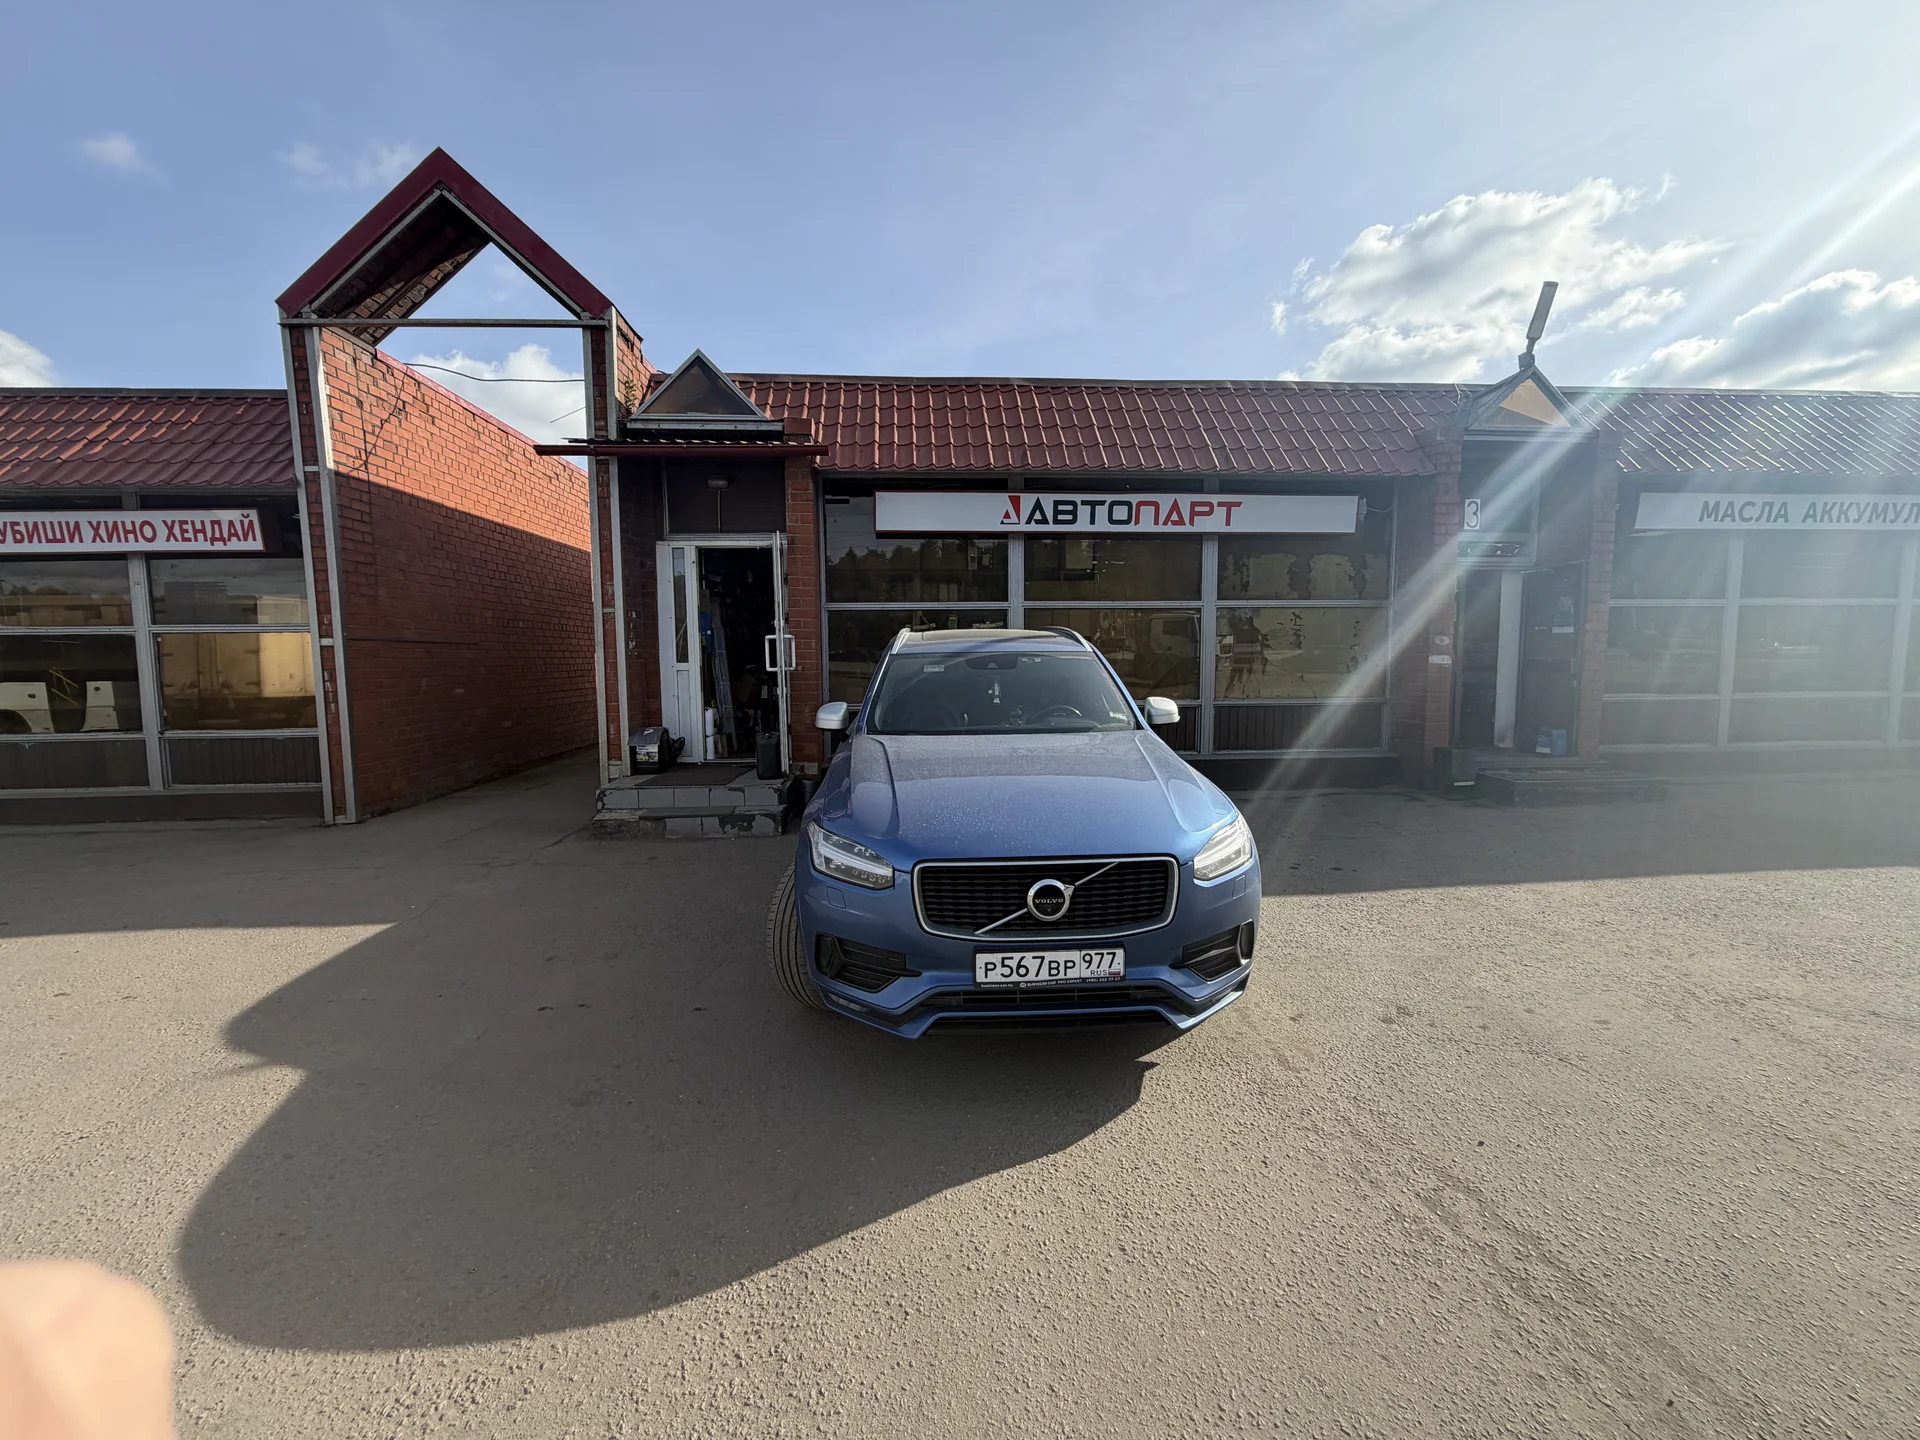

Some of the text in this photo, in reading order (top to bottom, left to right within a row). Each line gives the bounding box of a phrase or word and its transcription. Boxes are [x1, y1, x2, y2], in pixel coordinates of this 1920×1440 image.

[1024, 496, 1243, 527] АВТОПАРТ
[1466, 499, 1480, 529] 3
[1698, 500, 1790, 523] МАСЛА
[87, 519, 158, 543] ХИНО
[161, 513, 257, 547] ХЕНДАЙ
[1081, 952, 1117, 970] 977
